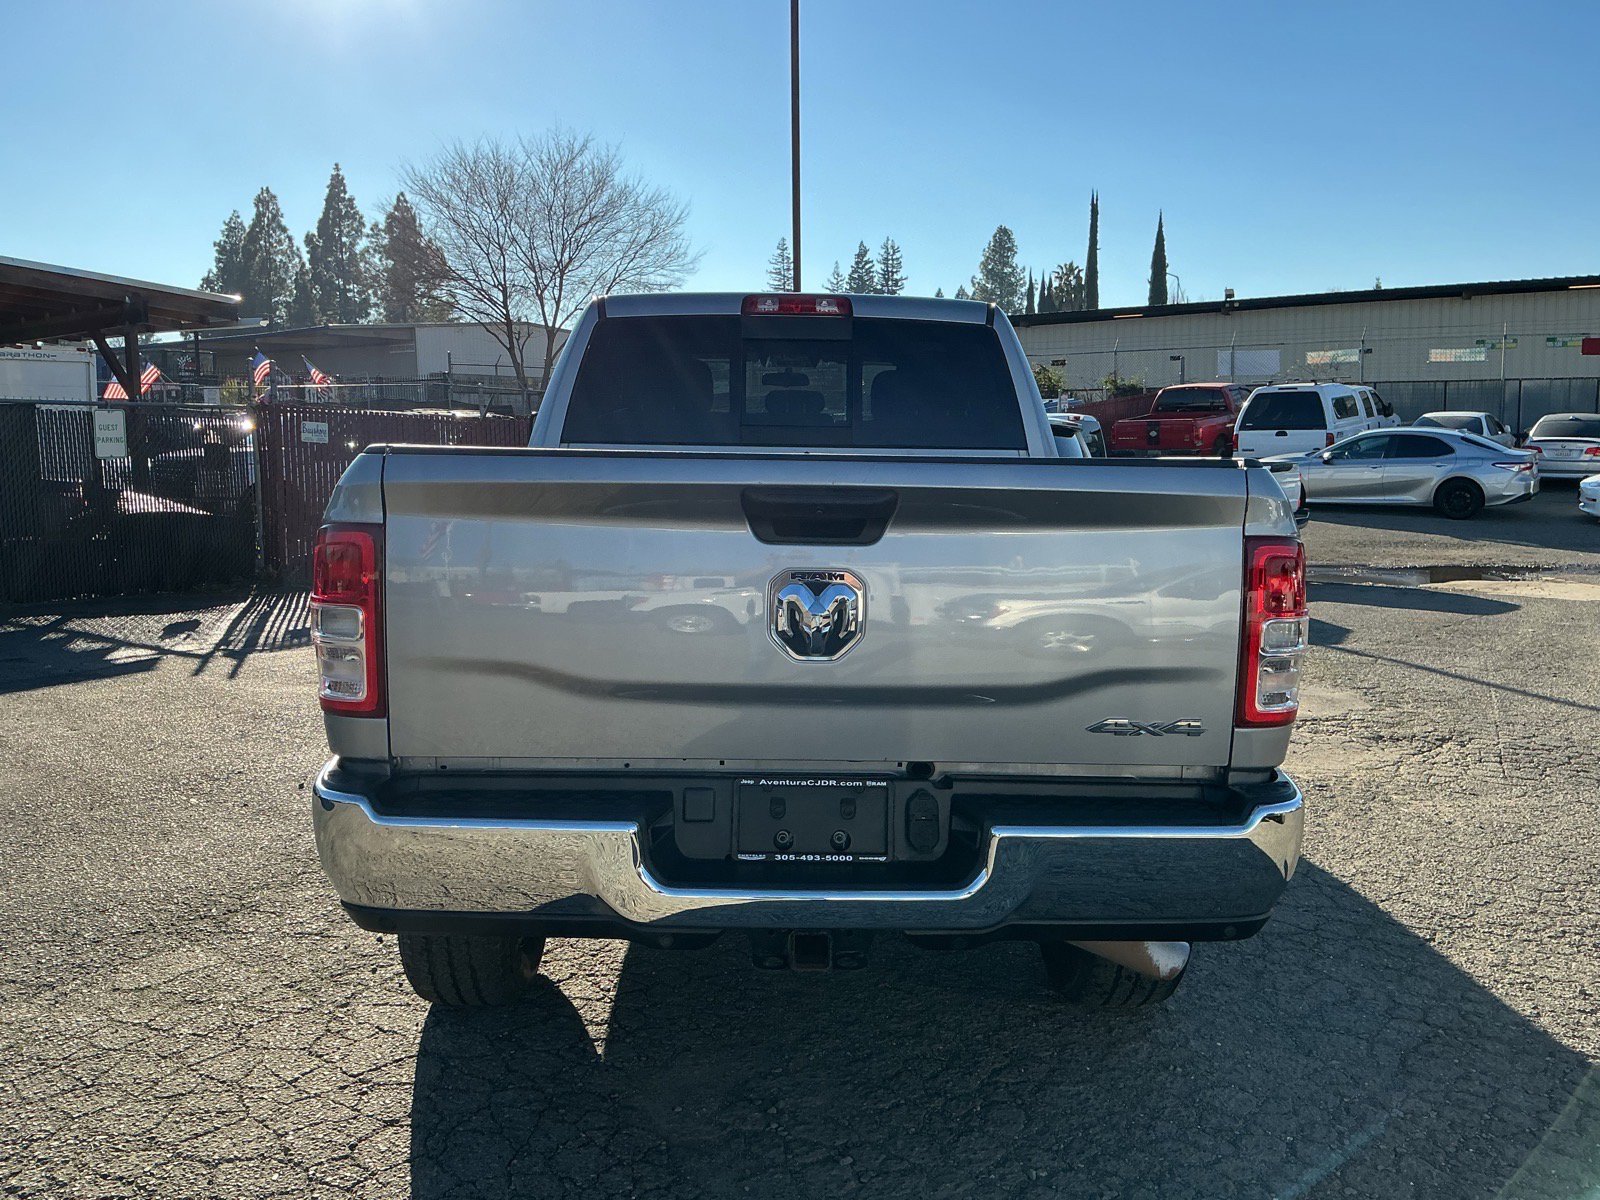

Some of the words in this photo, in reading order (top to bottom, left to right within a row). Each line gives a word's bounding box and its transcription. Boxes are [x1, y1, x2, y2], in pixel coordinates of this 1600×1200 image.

[96, 436, 124, 444] PARKING
[790, 572, 845, 581] RAM
[759, 779, 863, 787] AventuraCJDR.com
[774, 854, 853, 862] 305-493-5000
